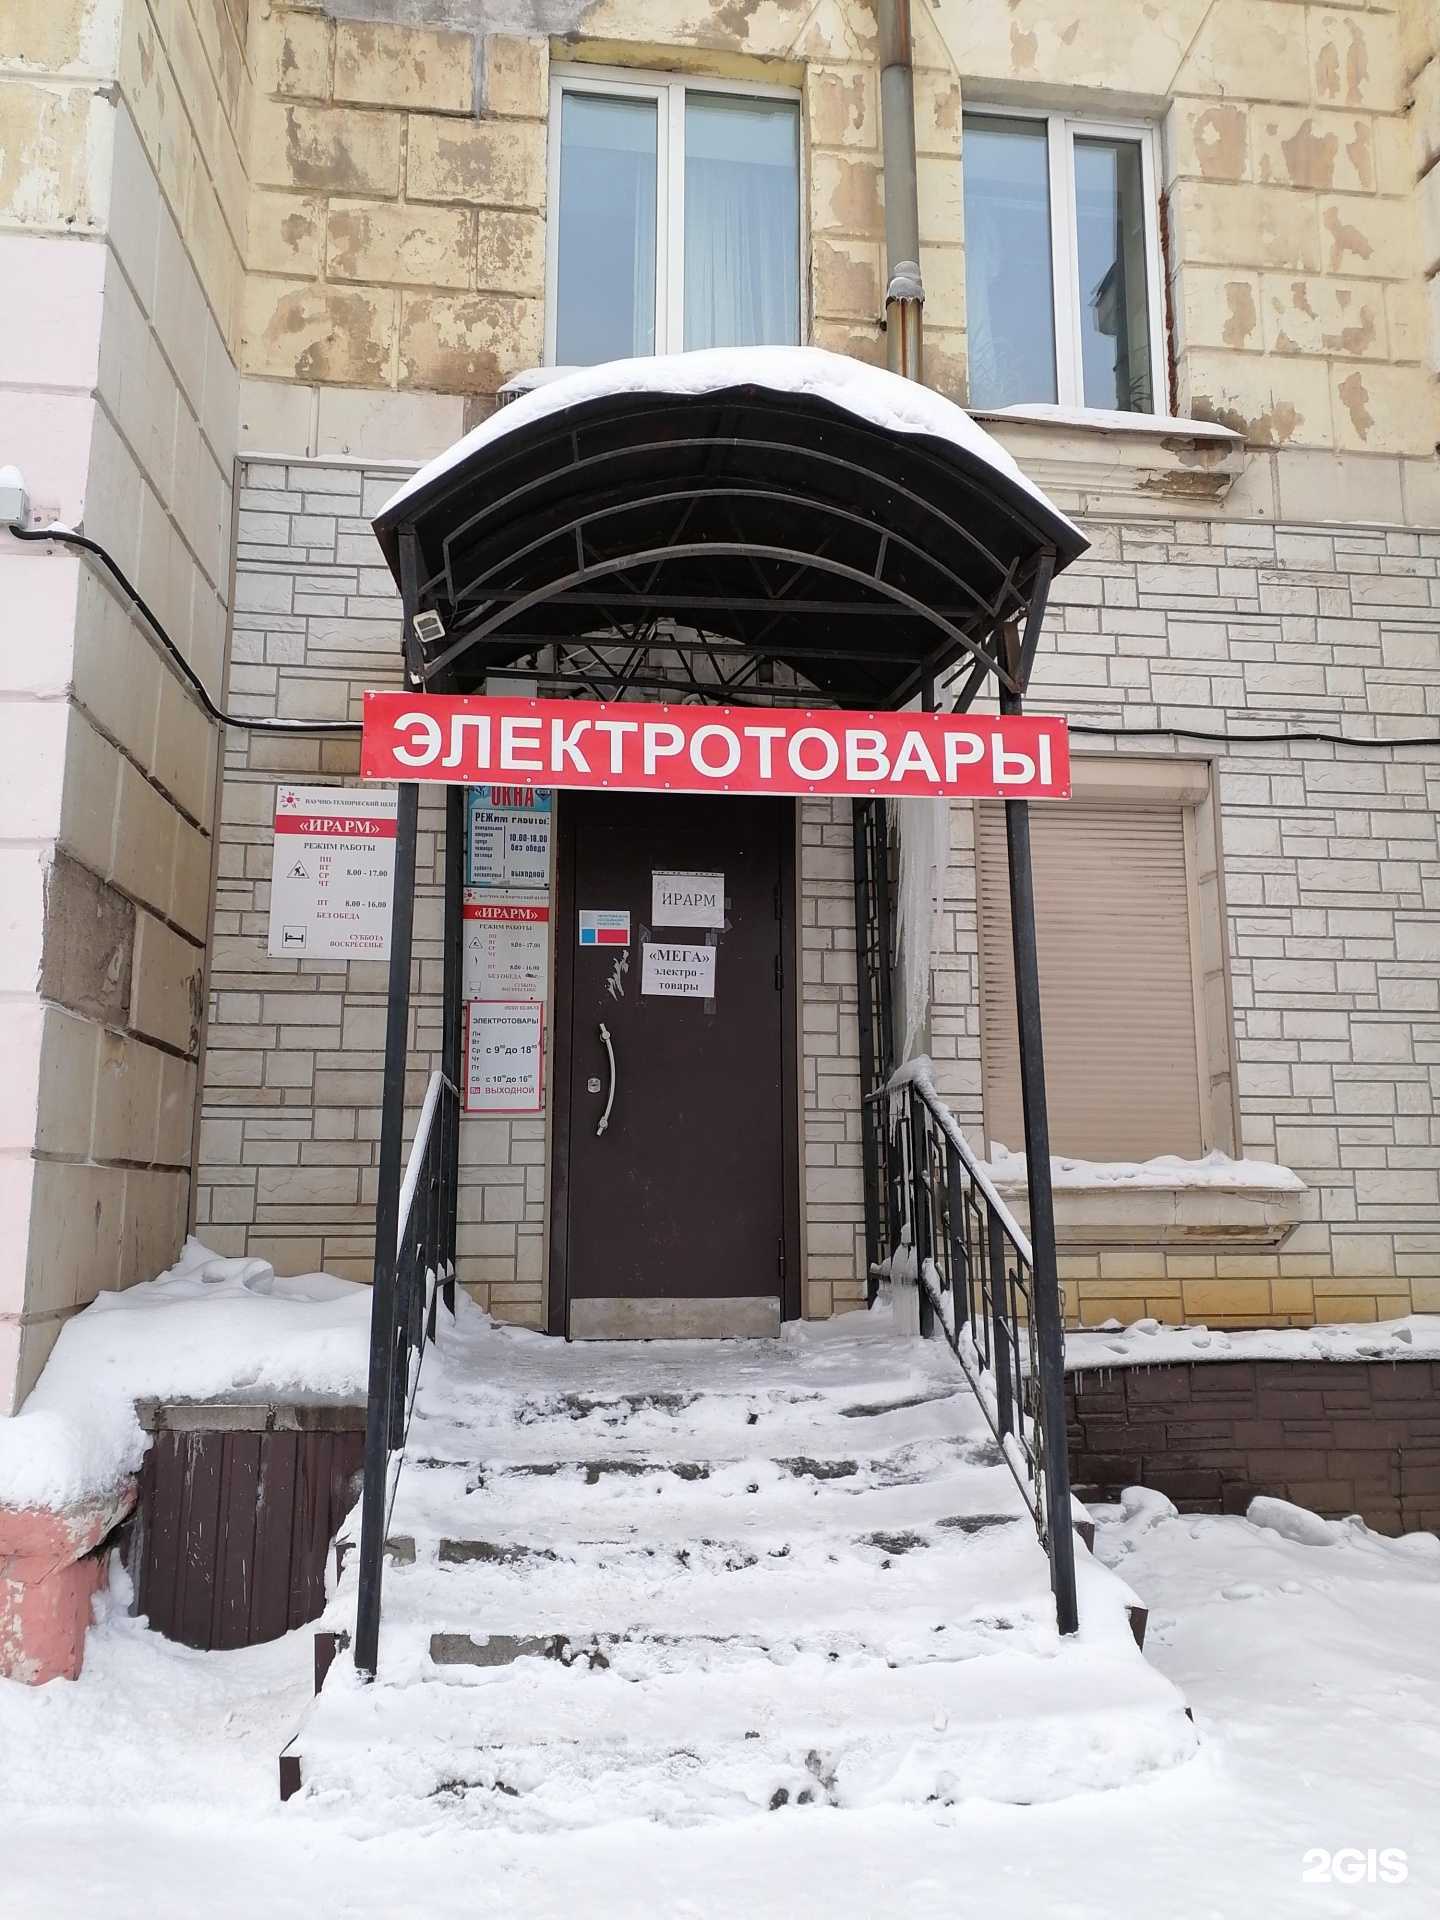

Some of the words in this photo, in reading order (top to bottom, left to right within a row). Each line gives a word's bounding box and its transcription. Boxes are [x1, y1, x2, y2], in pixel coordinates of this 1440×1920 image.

[392, 712, 1052, 787] ЭЛЕКТРОТОВАРЫ
[299, 818, 380, 834] «ИРАРМ»
[304, 842, 337, 850] РЕЖИМ
[340, 843, 376, 852] РАБОТЫ
[662, 892, 717, 907] ИРАРМ
[475, 907, 538, 920] «ИРАРМ»
[649, 949, 710, 963] «МЕГА»
[659, 982, 699, 992] товары
[473, 1017, 539, 1025] ЭЛЕКТРОТОВАРЫ
